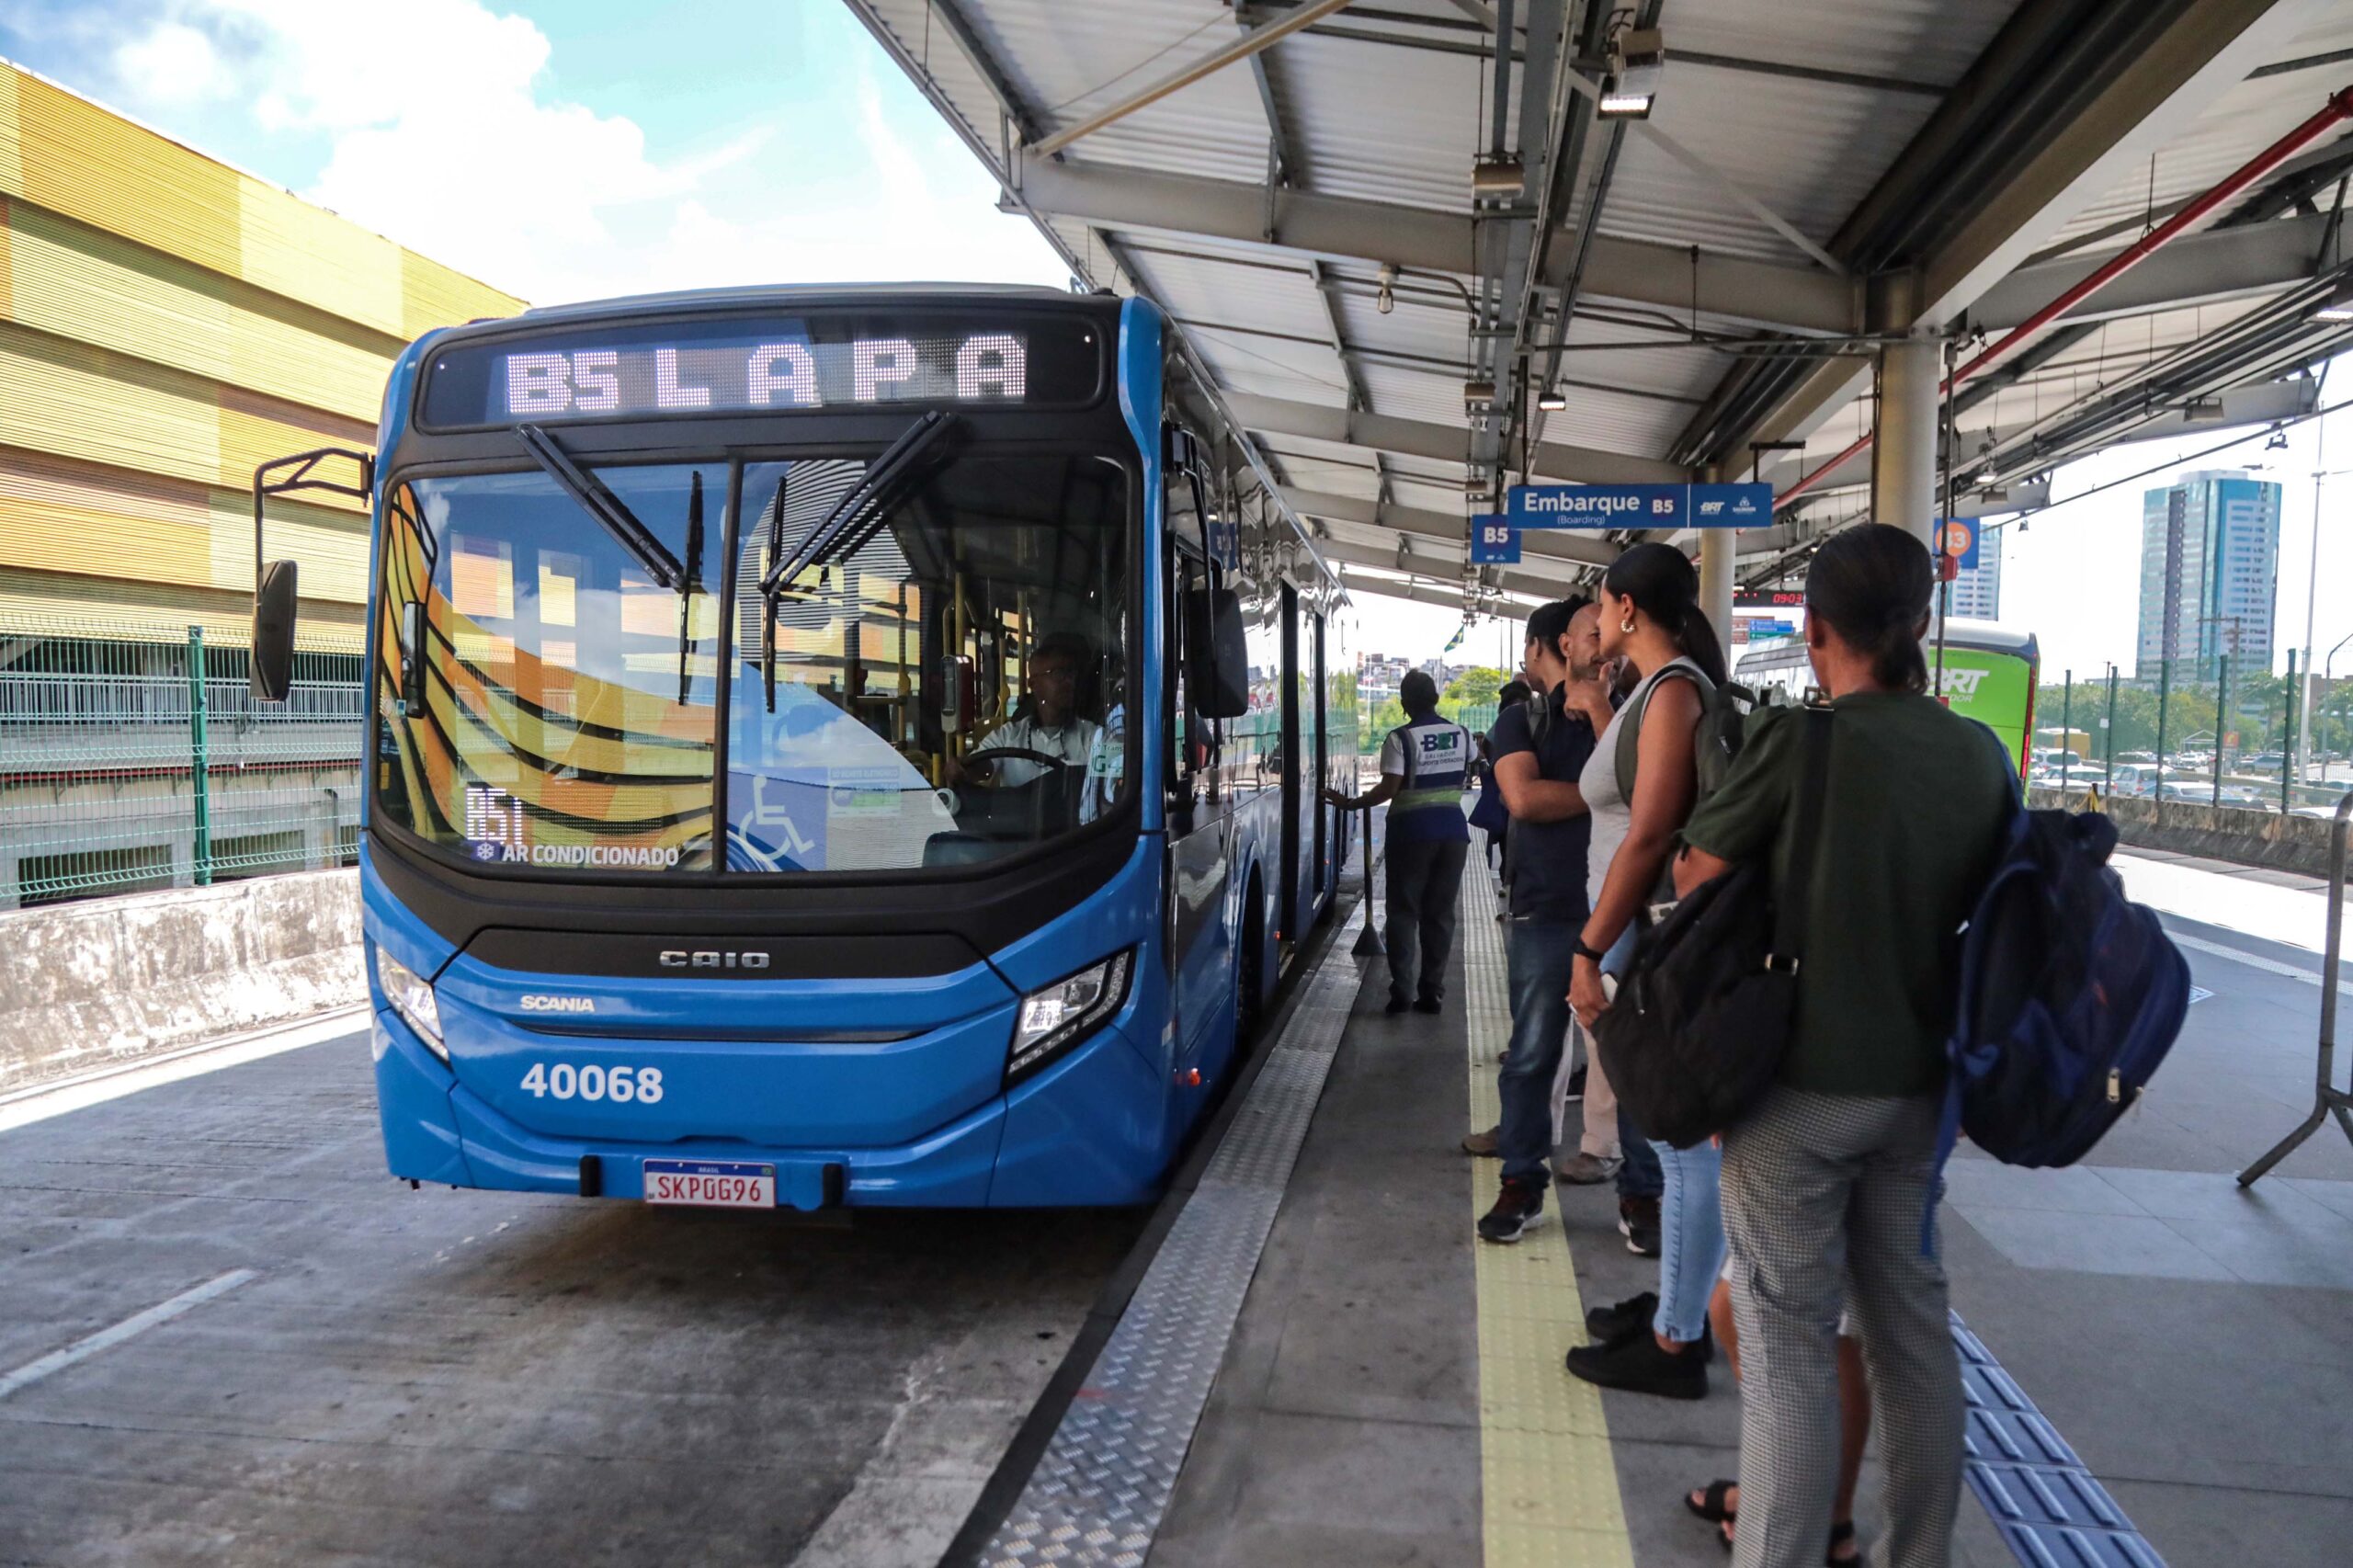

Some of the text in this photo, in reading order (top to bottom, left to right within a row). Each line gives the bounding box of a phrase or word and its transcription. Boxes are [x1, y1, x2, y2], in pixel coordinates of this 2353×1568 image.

[1524, 492, 1674, 517] Embarque B5
[1557, 515, 1606, 526] (Boarding)
[1483, 527, 1509, 544] B5
[1773, 594, 1802, 604] 09:03
[1420, 731, 1461, 752] BRT
[502, 844, 679, 866] AR CONDICIONADO
[659, 950, 770, 969] CAIO
[519, 994, 596, 1012] SCANIA
[519, 1062, 664, 1104] 40068
